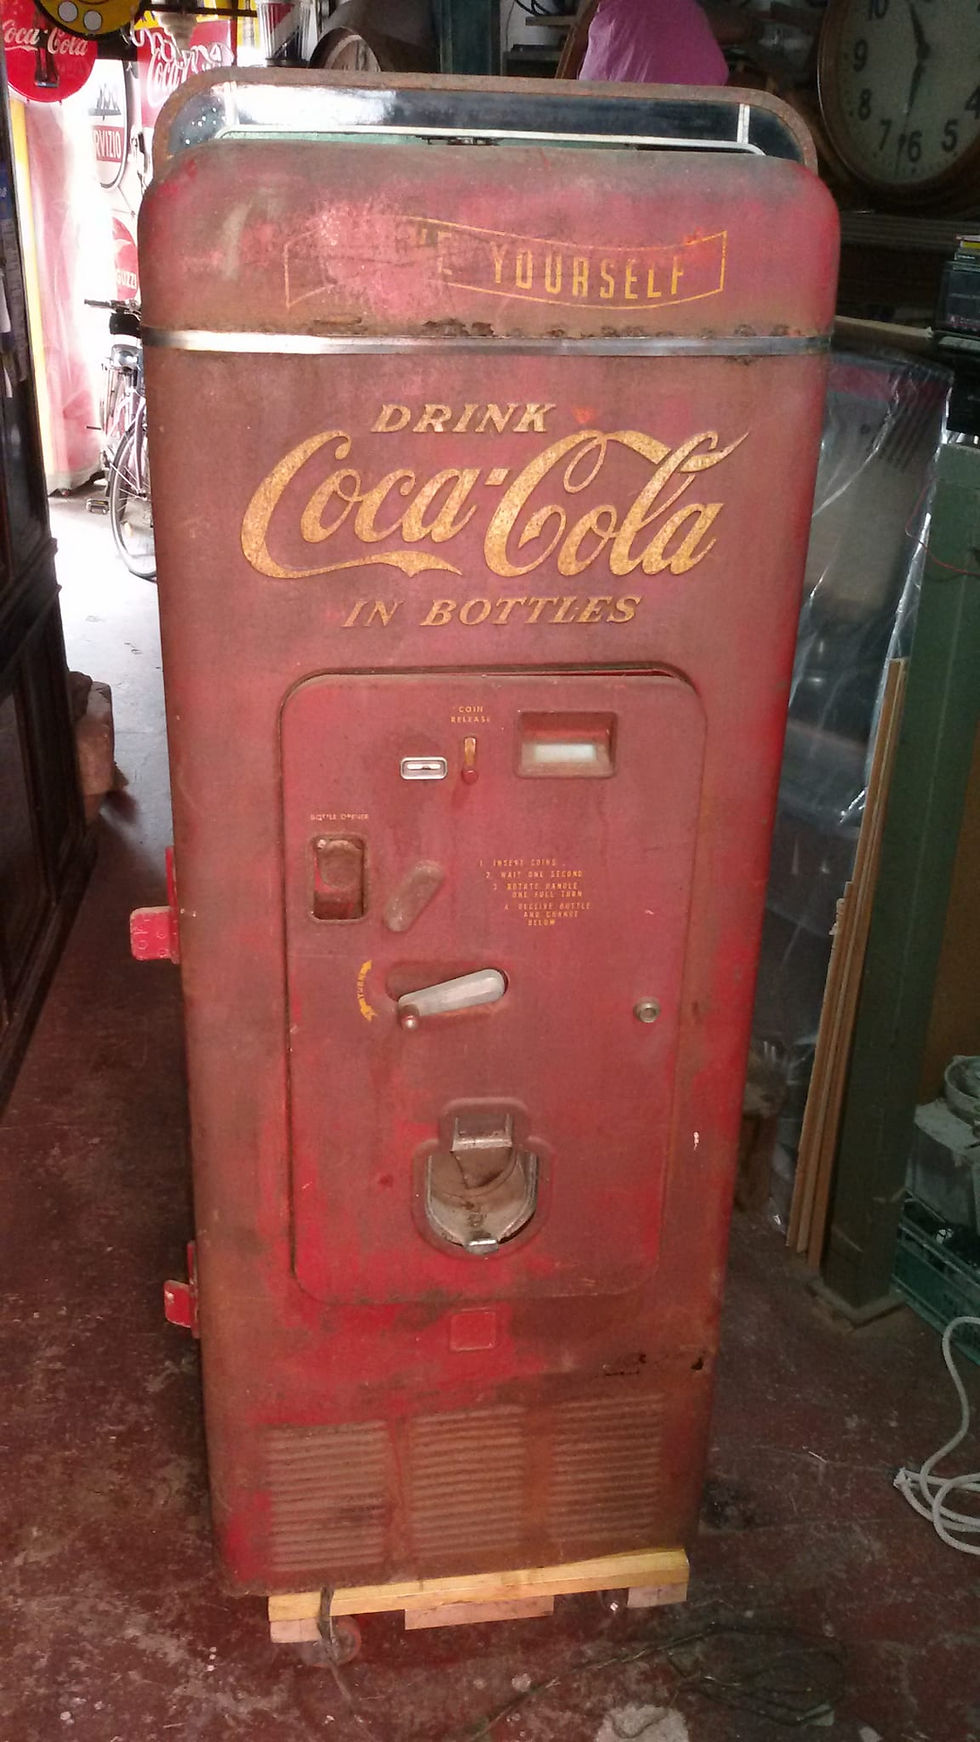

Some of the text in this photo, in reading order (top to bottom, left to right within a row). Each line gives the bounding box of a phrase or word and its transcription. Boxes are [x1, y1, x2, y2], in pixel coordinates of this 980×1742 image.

[853, 38, 869, 72] 9
[857, 88, 872, 120] 8
[964, 85, 980, 120] 4
[878, 118, 893, 151] 7
[907, 130, 923, 163] 6
[941, 118, 959, 152] 5
[489, 240, 685, 300] YOURSELF
[370, 403, 556, 433] DRINK
[240, 429, 750, 579] Coca-Cola
[341, 595, 642, 628] IN BOTTLES
[458, 705, 484, 713] COIN
[501, 871, 521, 879] WAIT
